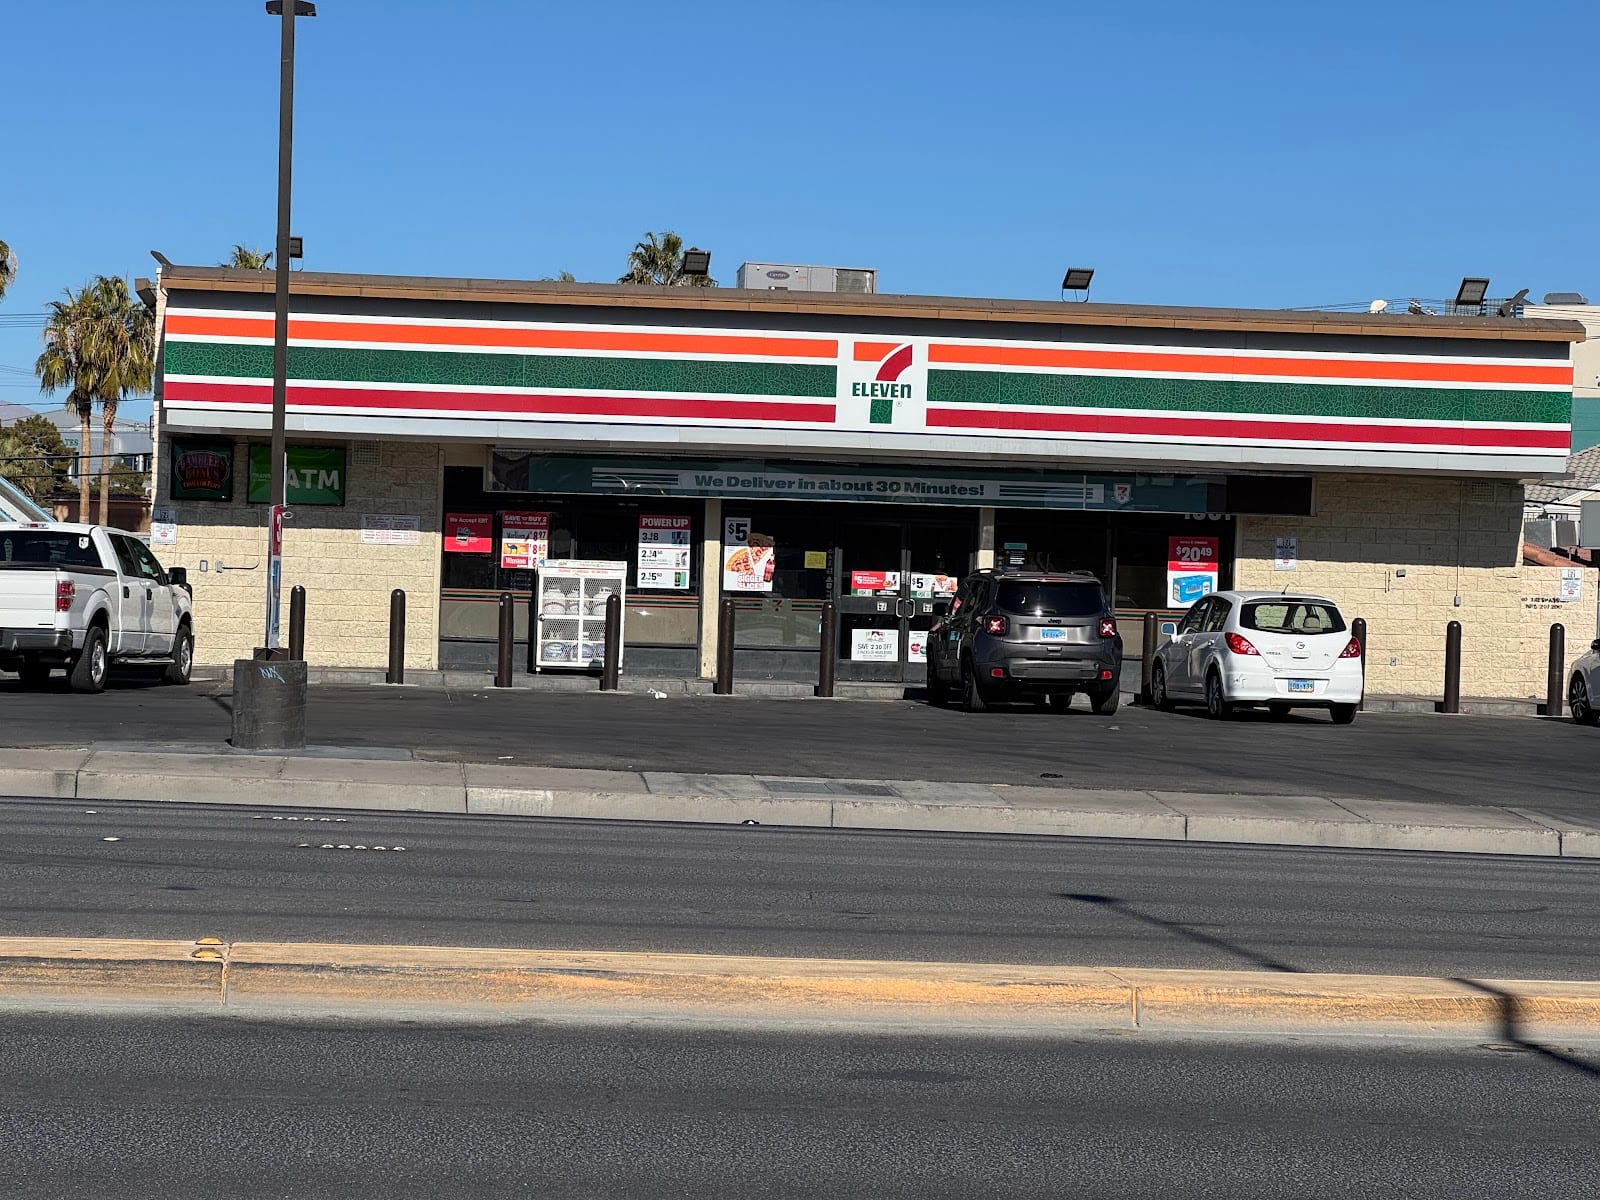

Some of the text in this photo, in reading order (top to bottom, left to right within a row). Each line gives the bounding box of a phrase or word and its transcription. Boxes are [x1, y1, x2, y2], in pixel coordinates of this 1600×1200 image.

[286, 469, 340, 490] ATM
[694, 475, 985, 496] We Deliver in about 30 Minutes!
[642, 518, 689, 527] POWER UP
[728, 522, 748, 542] $5
[912, 577, 924, 589] $5
